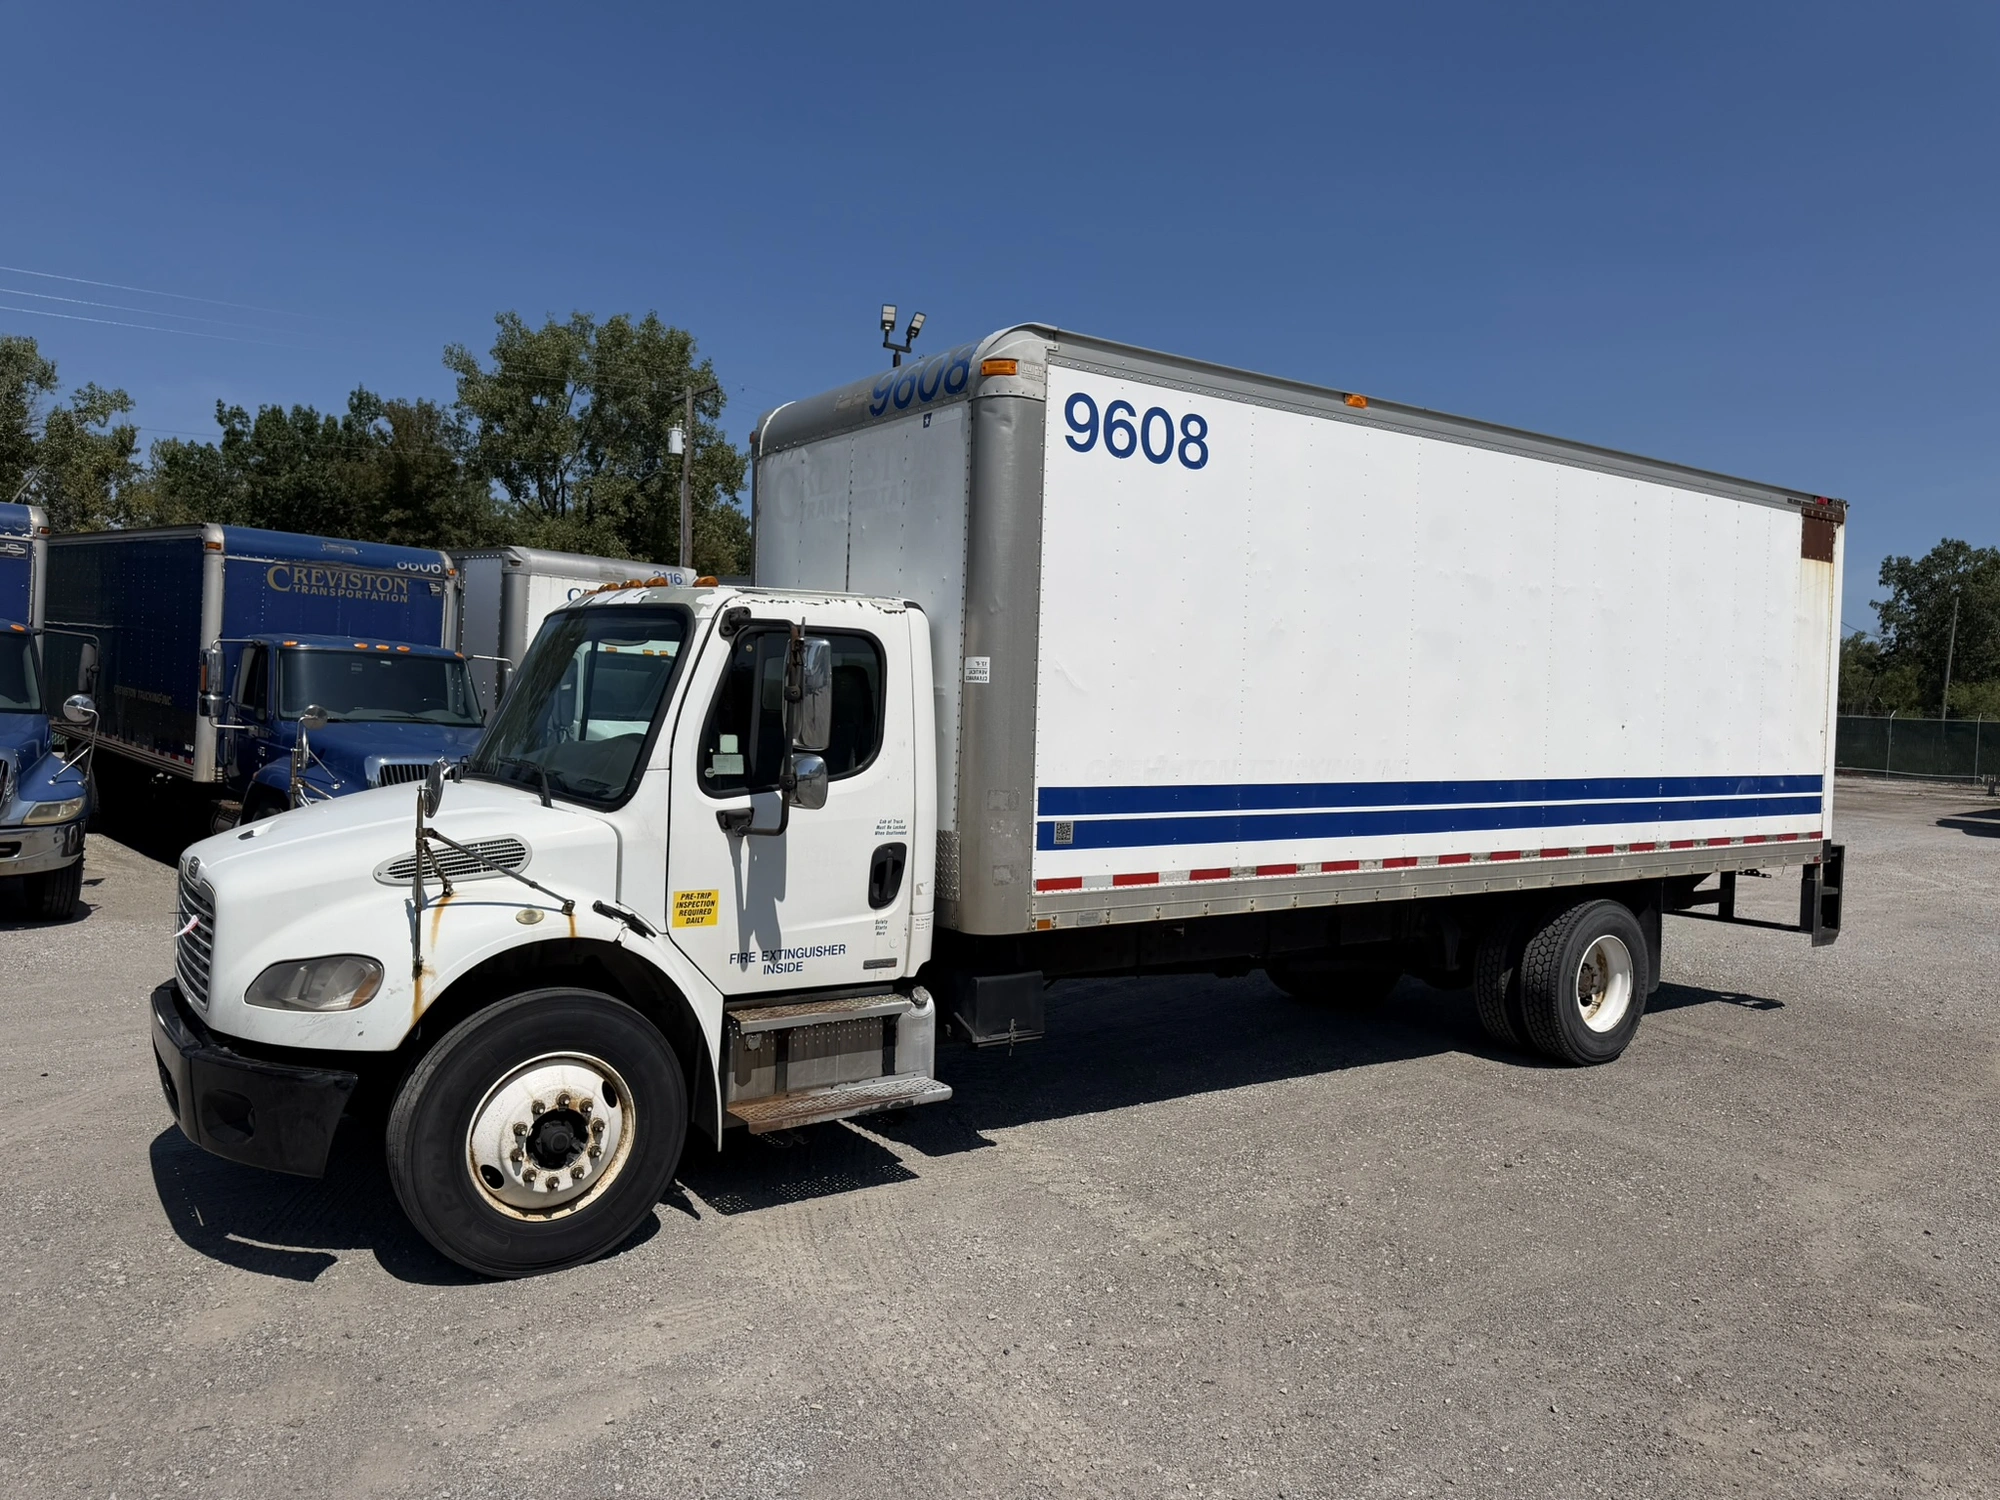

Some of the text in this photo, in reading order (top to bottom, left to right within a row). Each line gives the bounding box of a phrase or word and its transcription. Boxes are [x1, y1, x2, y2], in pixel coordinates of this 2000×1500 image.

[868, 344, 971, 417] 9608
[1064, 392, 1209, 471] 9608
[266, 565, 409, 594] CREVISTON
[293, 584, 408, 603] TRANSPORTATION
[680, 892, 712, 900] PRE-TRIP
[676, 900, 716, 909] INSPECTION
[678, 908, 713, 917] REQUIRED
[685, 916, 705, 924] DAILY
[729, 943, 847, 965] FIRE EXTINGUISHER
[762, 961, 804, 975] INSIDE
